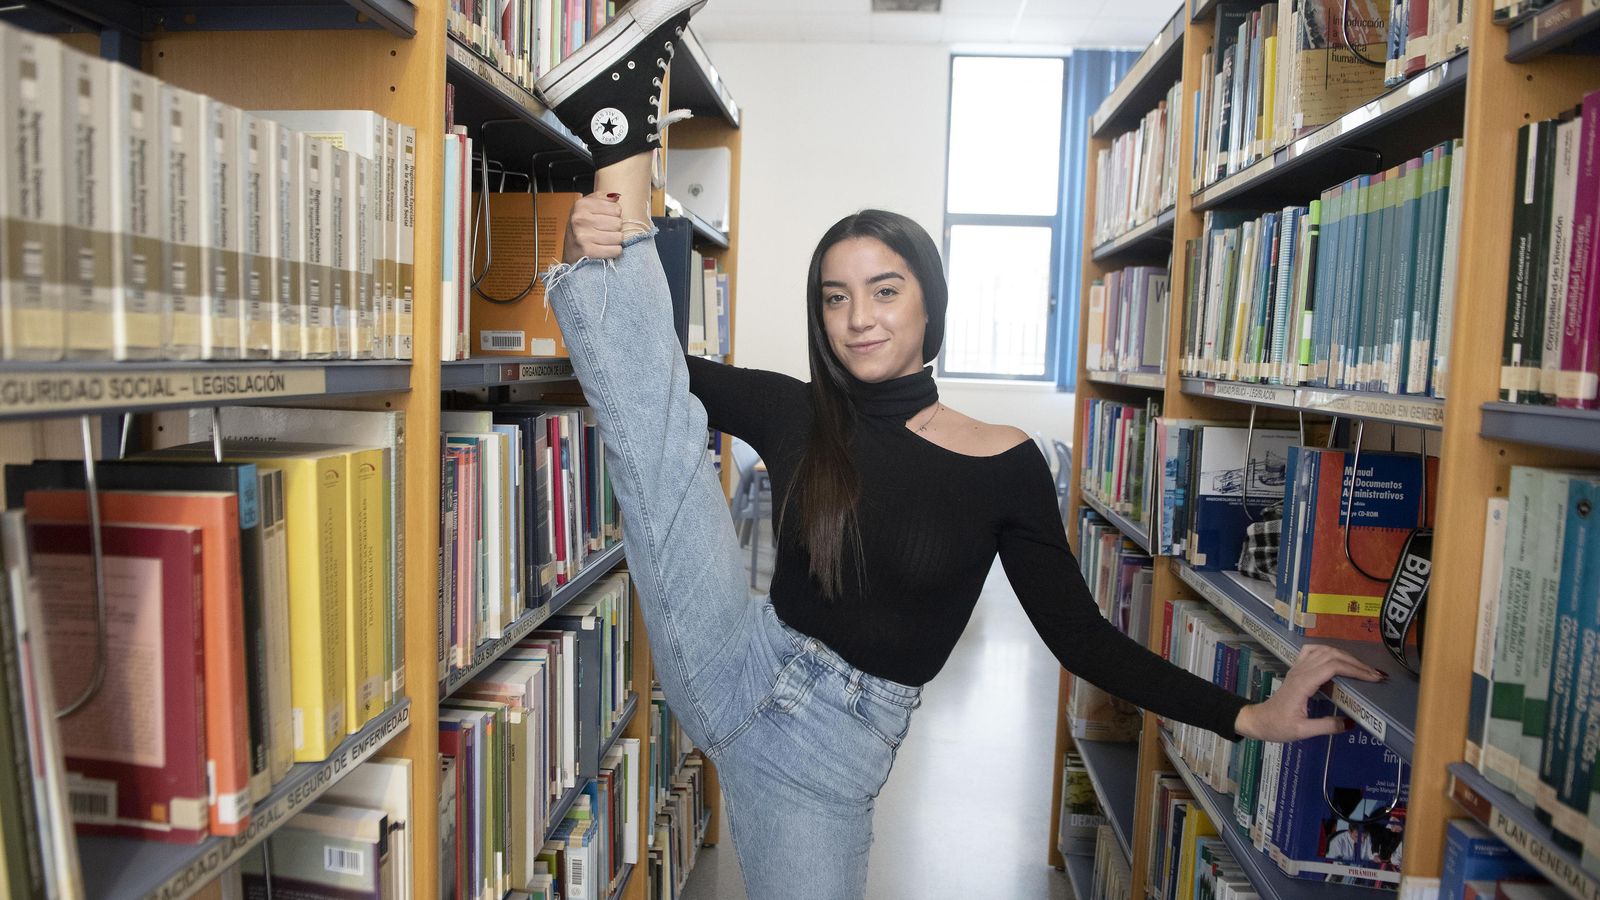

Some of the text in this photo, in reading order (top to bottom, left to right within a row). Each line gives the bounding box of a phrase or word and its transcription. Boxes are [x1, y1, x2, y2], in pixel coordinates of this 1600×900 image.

[1333, 16, 1384, 28] Inoducción
[1332, 52, 1366, 64] human
[1517, 237, 1526, 282] Contabilidad
[1545, 284, 1558, 351] Contabilidad
[0, 370, 285, 405] GURIDAD SOCIAL LEGISLACIÓN
[1410, 407, 1444, 421] GENERA
[1344, 466, 1374, 477] Mnual
[1355, 478, 1403, 489] Documentos
[1342, 488, 1404, 500] Aministrativos
[1358, 510, 1379, 518] CD-ROM
[1384, 553, 1432, 640] BIMBA
[1509, 583, 1522, 654] CONTABILIDAD
[1542, 595, 1555, 669] CONTABILIDAD
[1554, 615, 1572, 694] CONTABILIDAD
[1577, 628, 1596, 712] CONTABILIDAD
[1337, 687, 1383, 734] TRANSPORTES
[1349, 735, 1355, 744] a
[1359, 731, 1367, 745] la
[1384, 749, 1398, 764] fin
[149, 852, 218, 900] ACIDAD
[288, 765, 332, 810] SEGURO
[334, 752, 347, 774] DE
[352, 708, 409, 760] ENFERMEDAD
[1498, 814, 1587, 894] PLAN GENERAL
